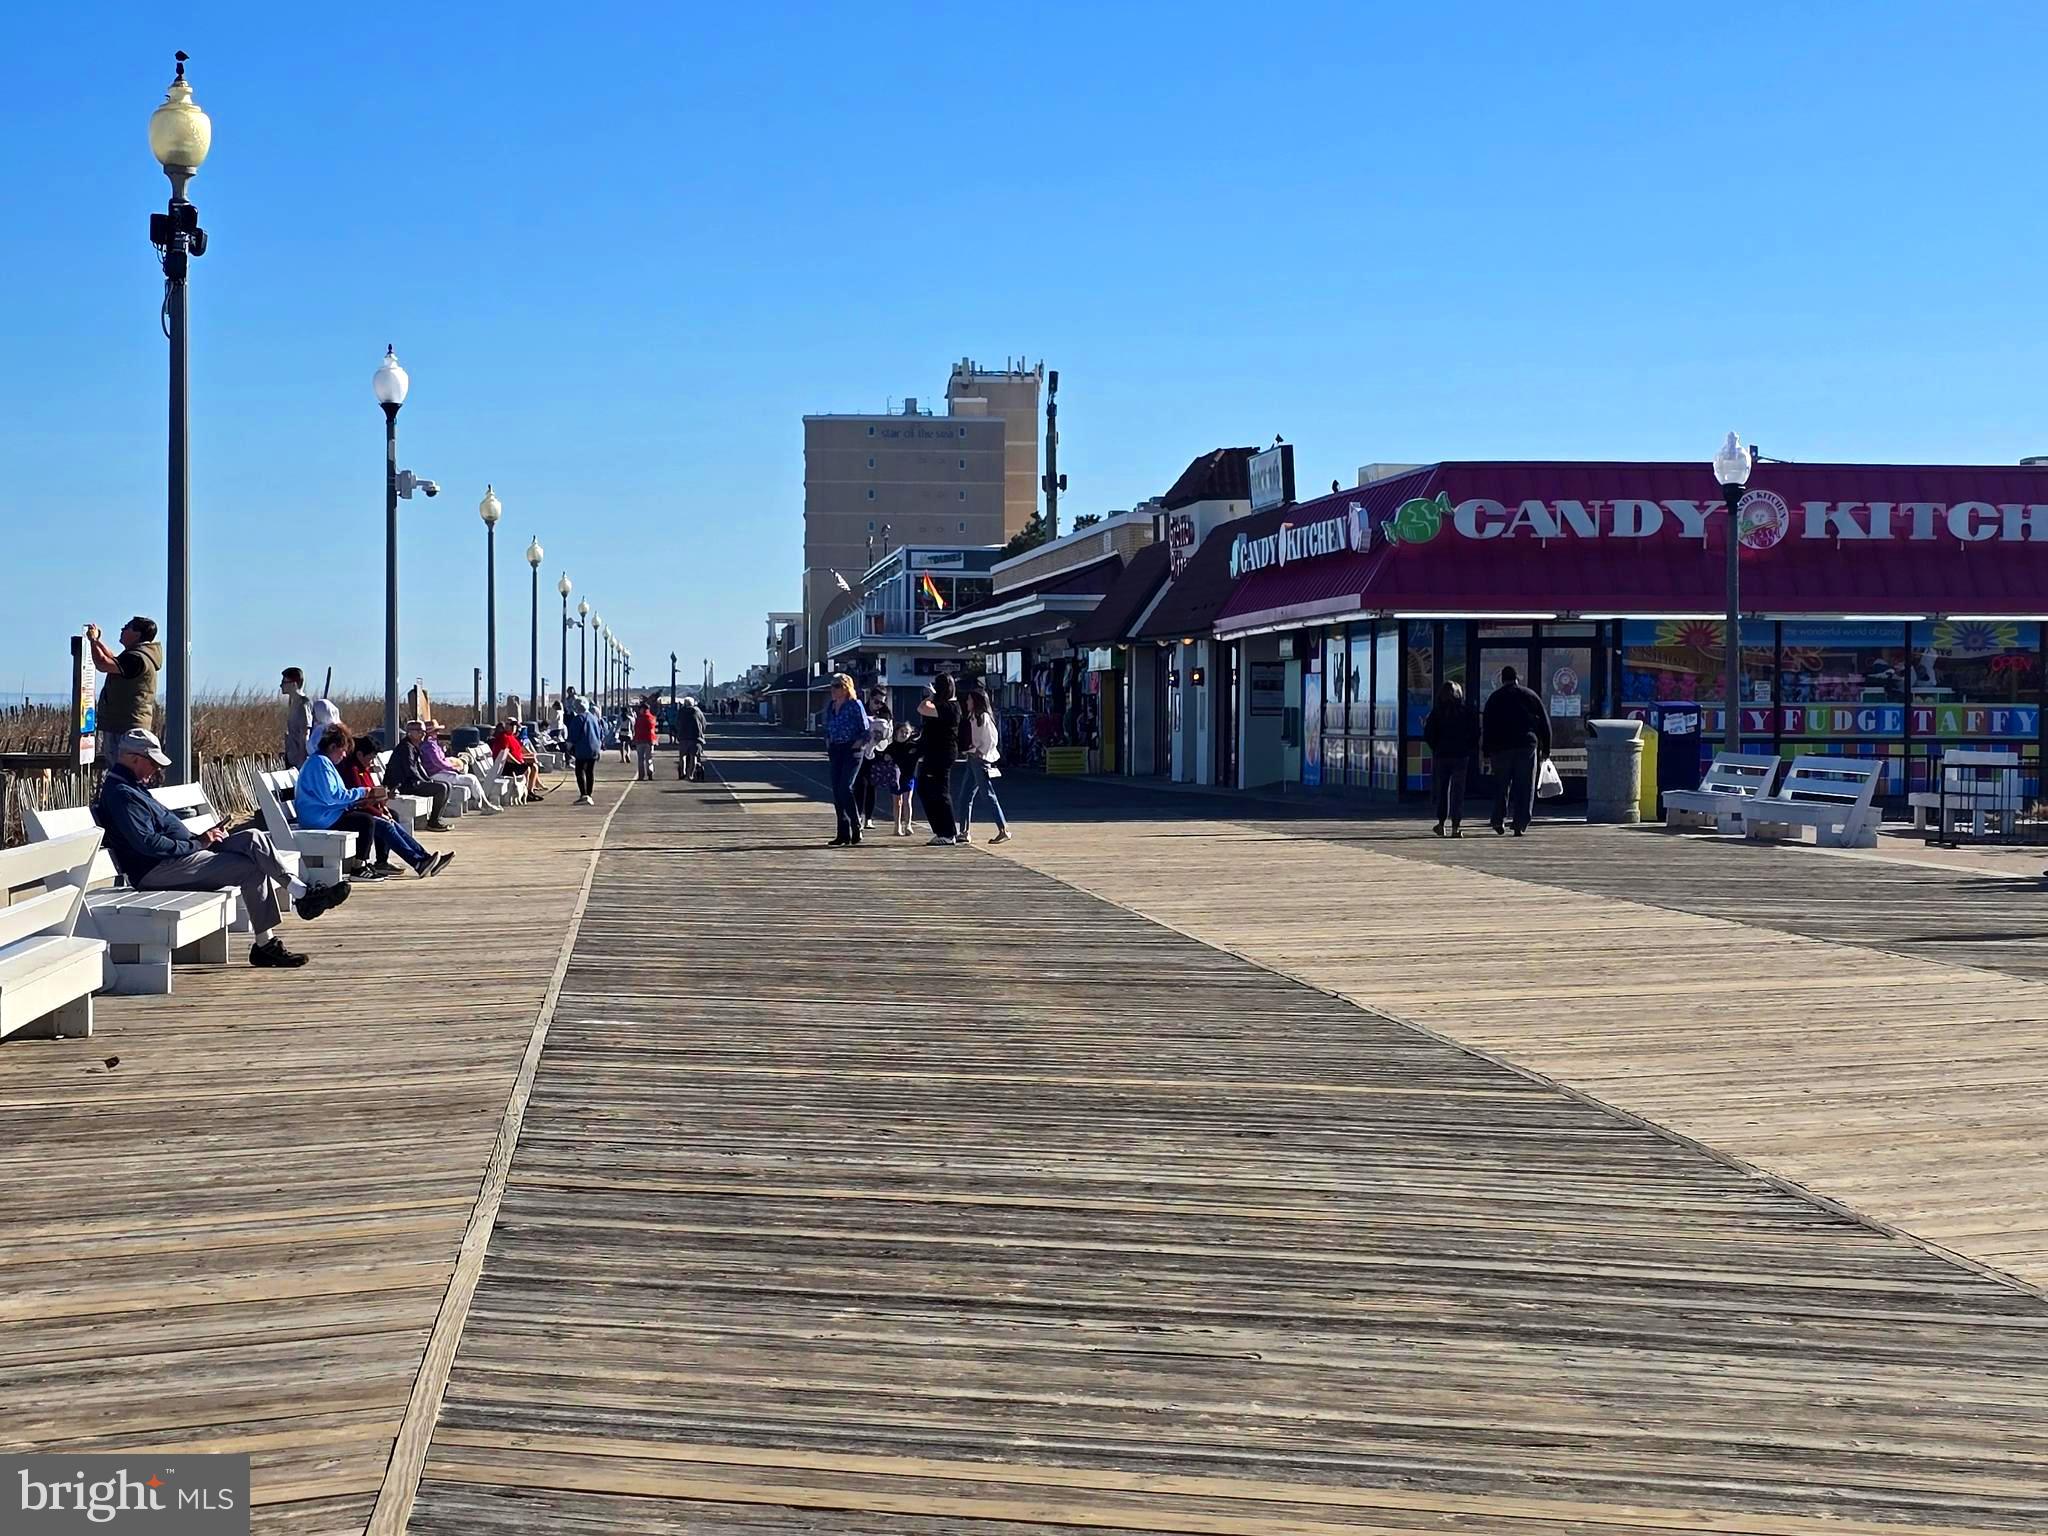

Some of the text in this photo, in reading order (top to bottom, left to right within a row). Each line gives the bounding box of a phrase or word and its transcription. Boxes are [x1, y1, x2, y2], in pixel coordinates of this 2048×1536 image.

[1453, 498, 1728, 539] CANDY
[1240, 515, 1348, 574] CANDY KITCHEN
[1991, 655, 2034, 673] OPEN
[1783, 709, 1901, 732] FUDGE
[1913, 710, 2038, 733] TAFFY
